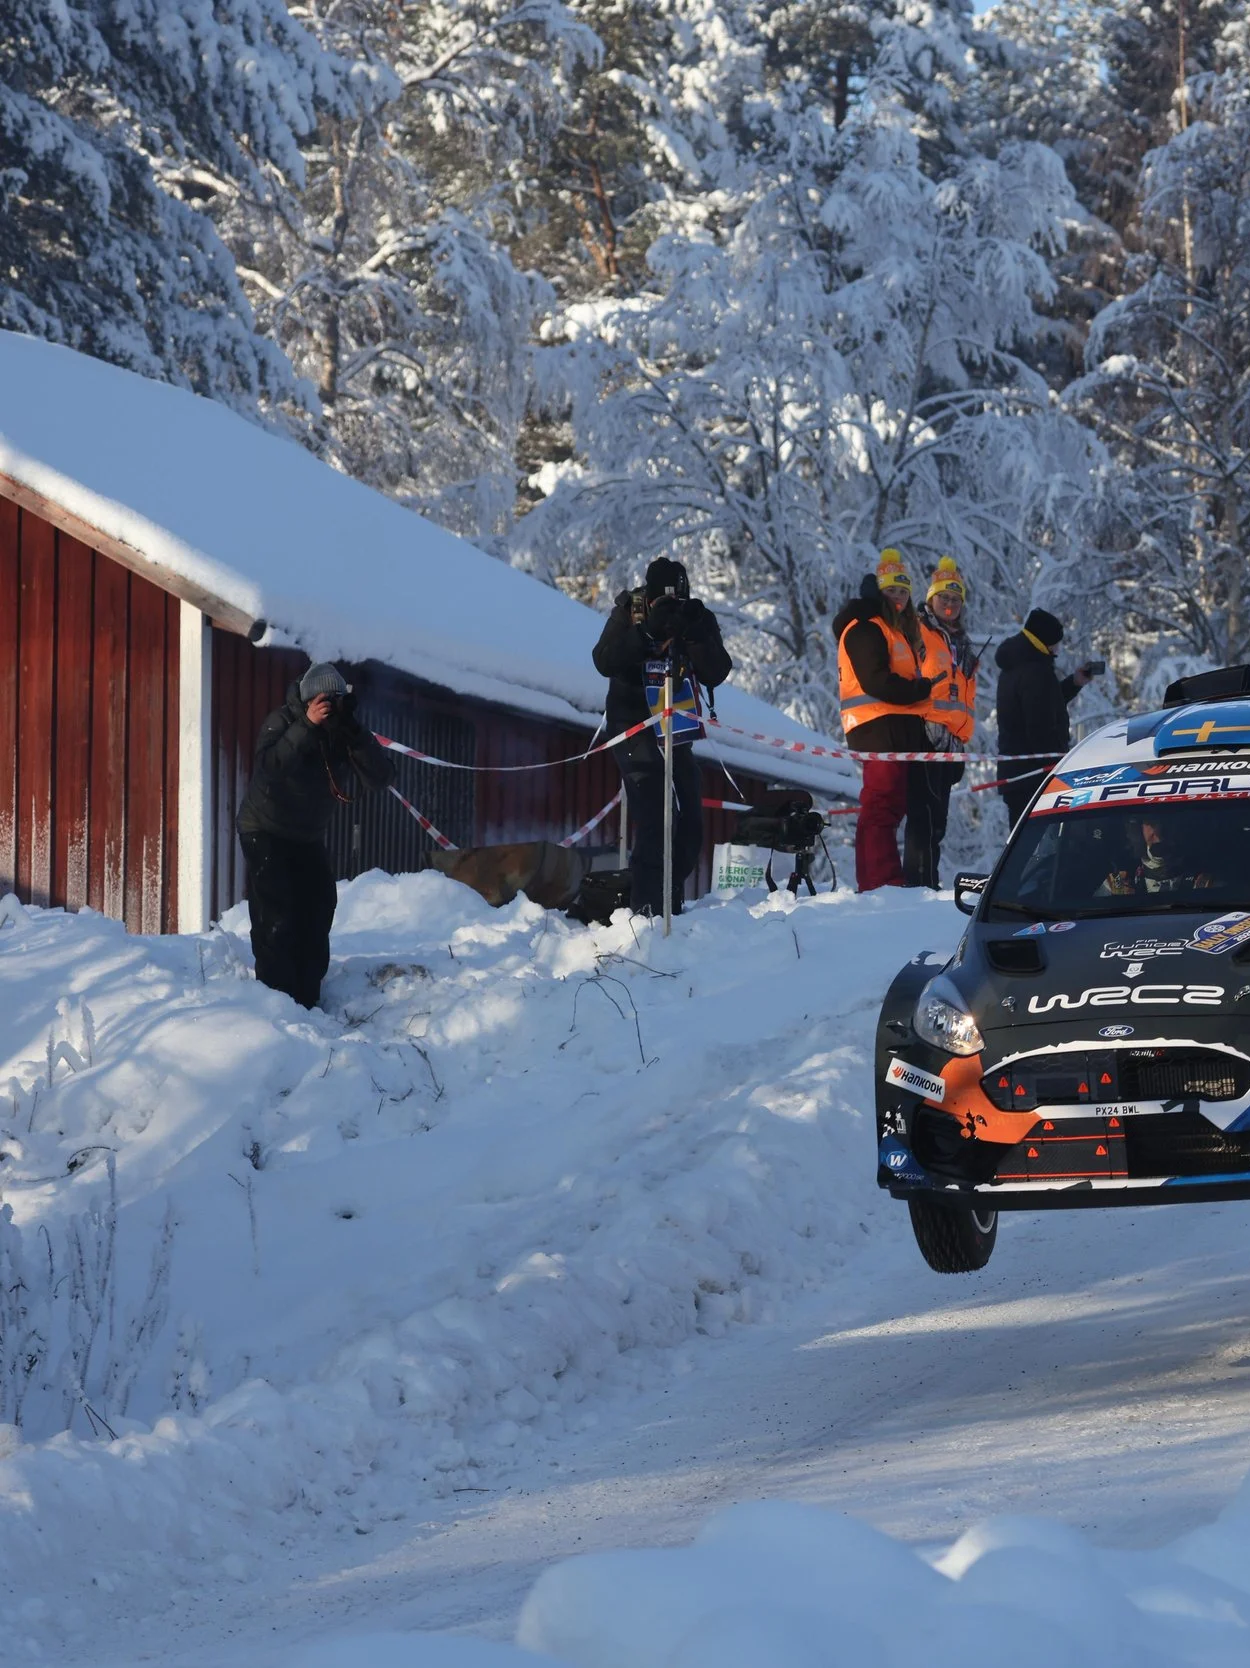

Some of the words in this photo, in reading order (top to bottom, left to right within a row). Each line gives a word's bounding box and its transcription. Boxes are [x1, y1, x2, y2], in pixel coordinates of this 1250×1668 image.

[1028, 984, 1225, 1014] WRC2
[1104, 1026, 1129, 1037] Ford
[1095, 1105, 1119, 1116] PX24
[1122, 1104, 1140, 1115] BWL
[890, 1154, 908, 1167] W
